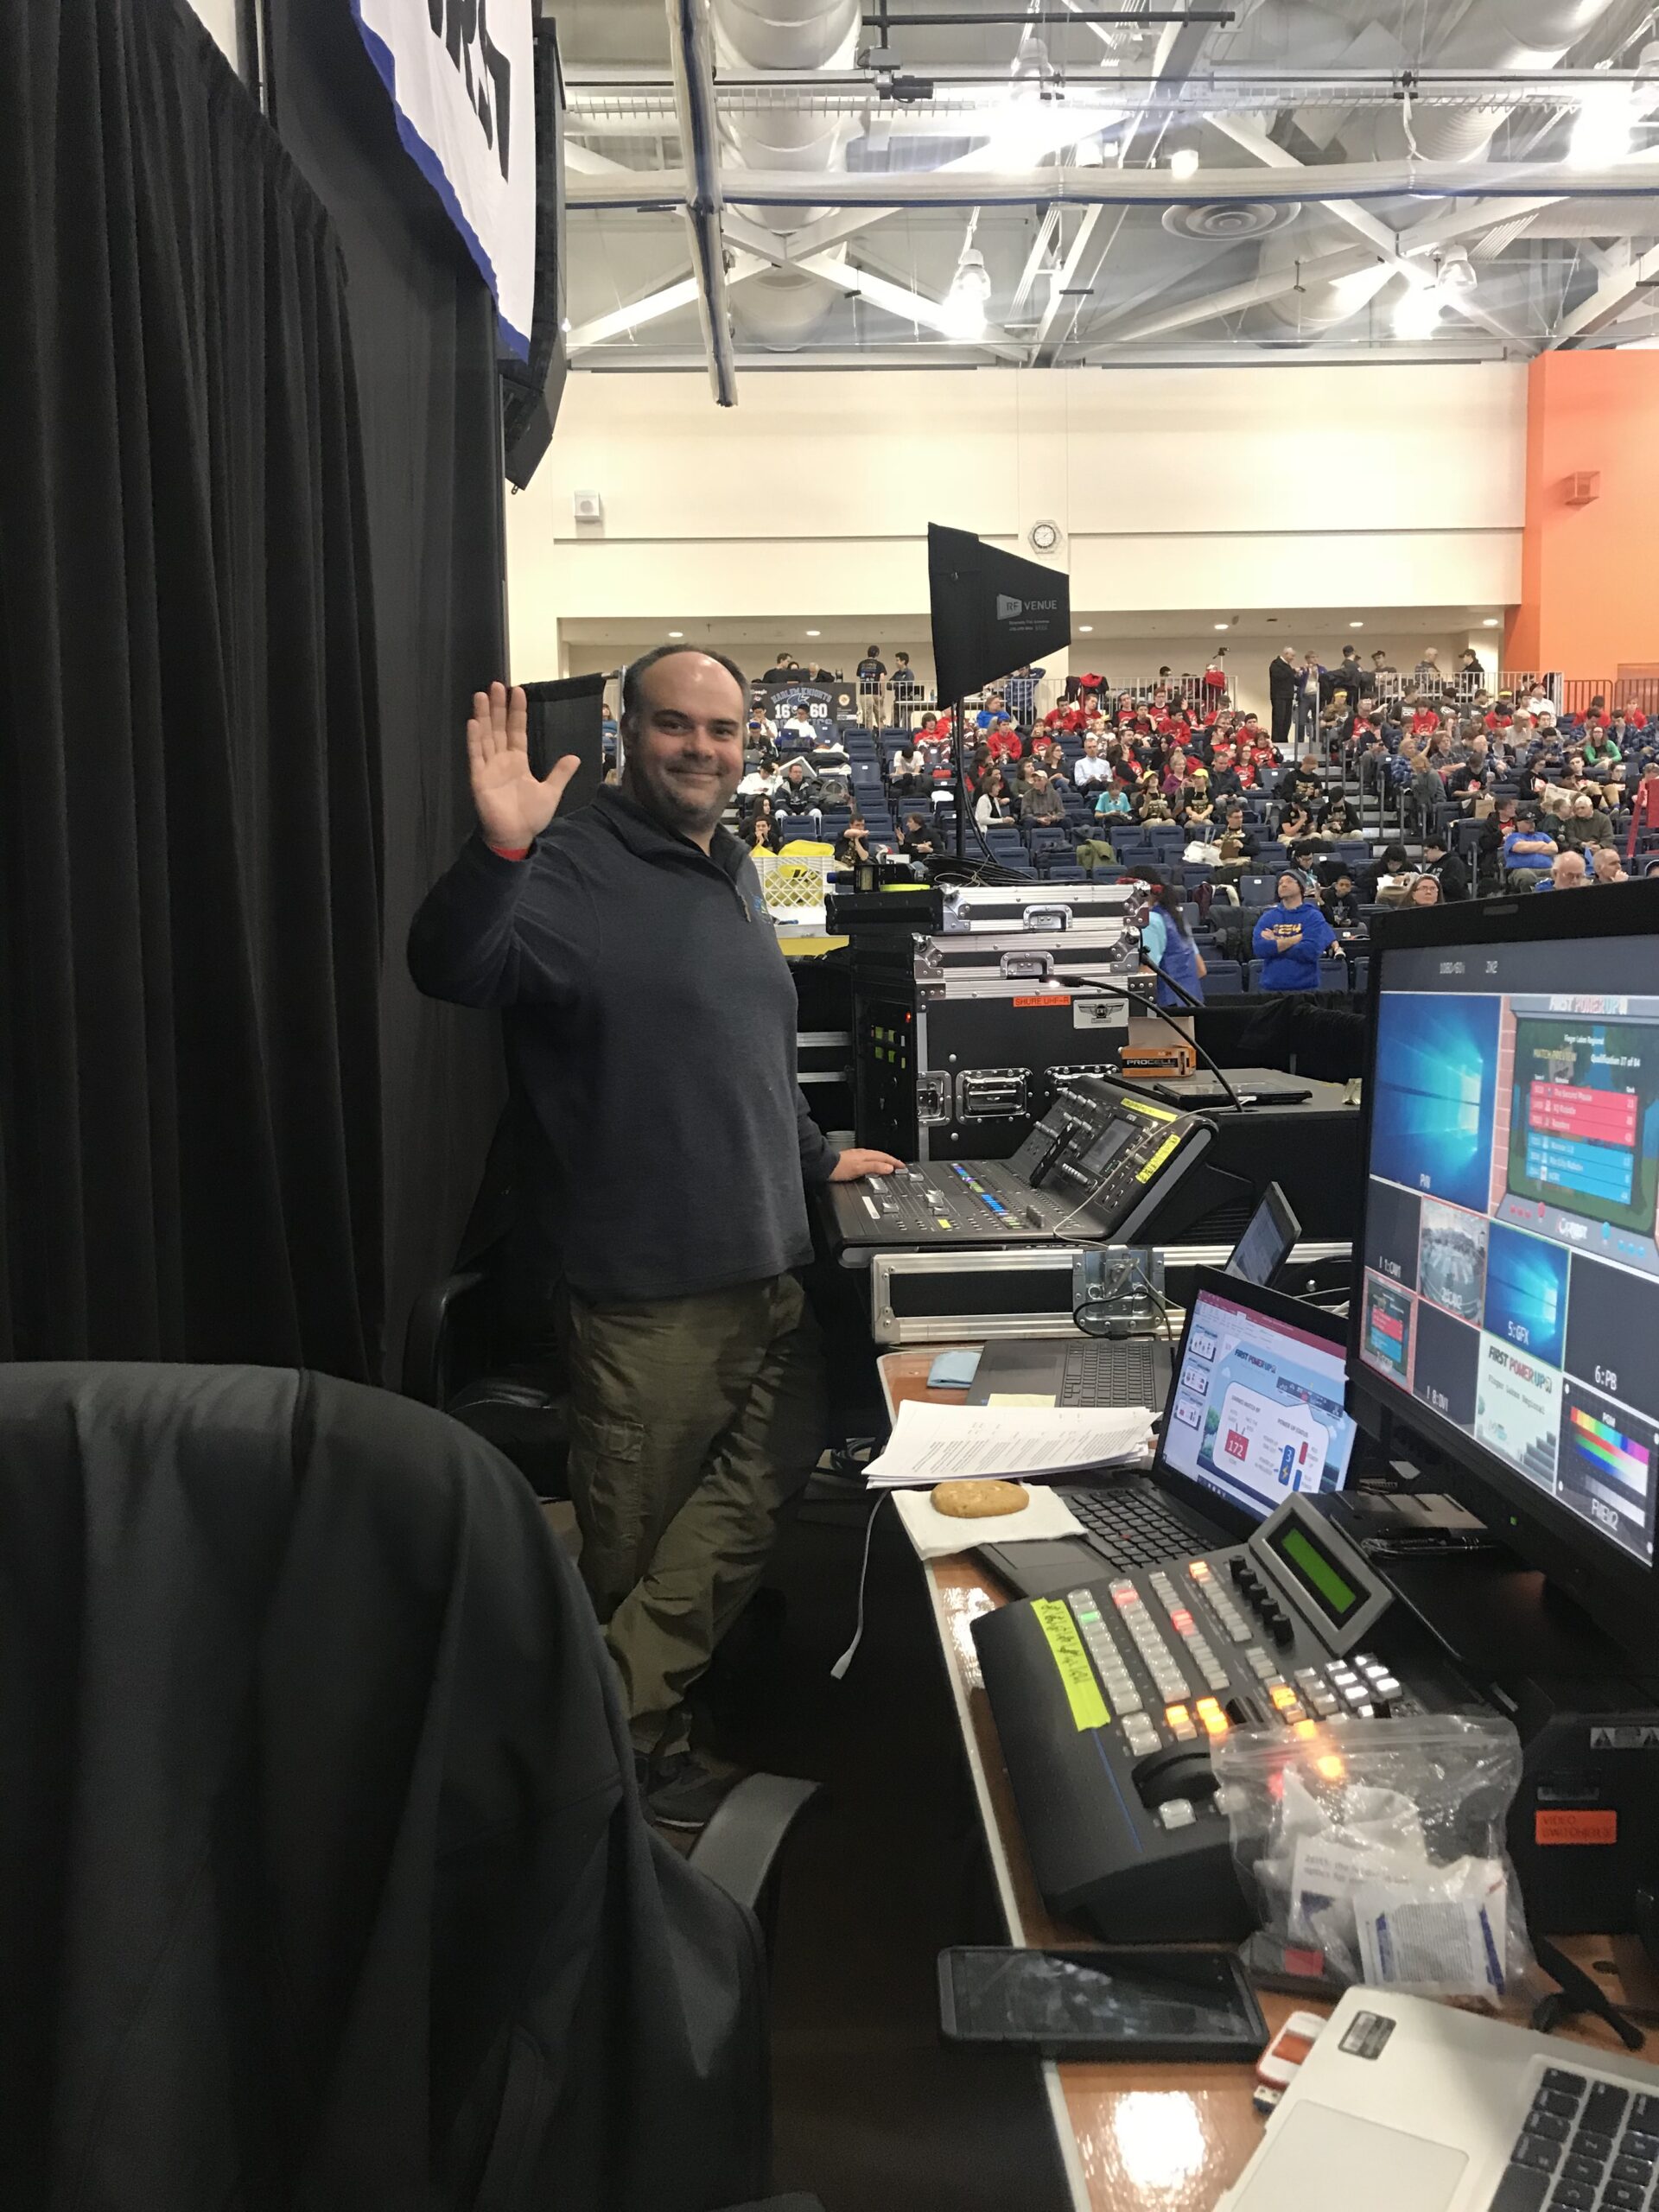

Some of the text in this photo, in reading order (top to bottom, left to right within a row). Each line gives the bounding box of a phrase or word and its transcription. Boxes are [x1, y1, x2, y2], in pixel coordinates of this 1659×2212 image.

[1006, 600, 1058, 611] RF VENUE
[771, 688, 799, 703] HARLEM
[801, 688, 832, 702] KNIGHTS
[775, 703, 791, 719] 16
[810, 702, 828, 718] 60
[1015, 995, 1069, 1006] SHURE UHF-R
[1591, 1054, 1619, 1065] Qualification
[1627, 1058, 1633, 1067] of
[1507, 1321, 1529, 1346] 5:GFX
[1235, 1349, 1249, 1360] FIRST
[1249, 1355, 1265, 1368] POWER
[1489, 1345, 1509, 1367] FIRST
[1510, 1357, 1534, 1382] POWER
[1595, 1365, 1617, 1390] 6:PB
[1228, 1440, 1243, 1457] 172
[1285, 1449, 1293, 1463] 3
[1543, 1815, 1576, 1826] VIDEO
